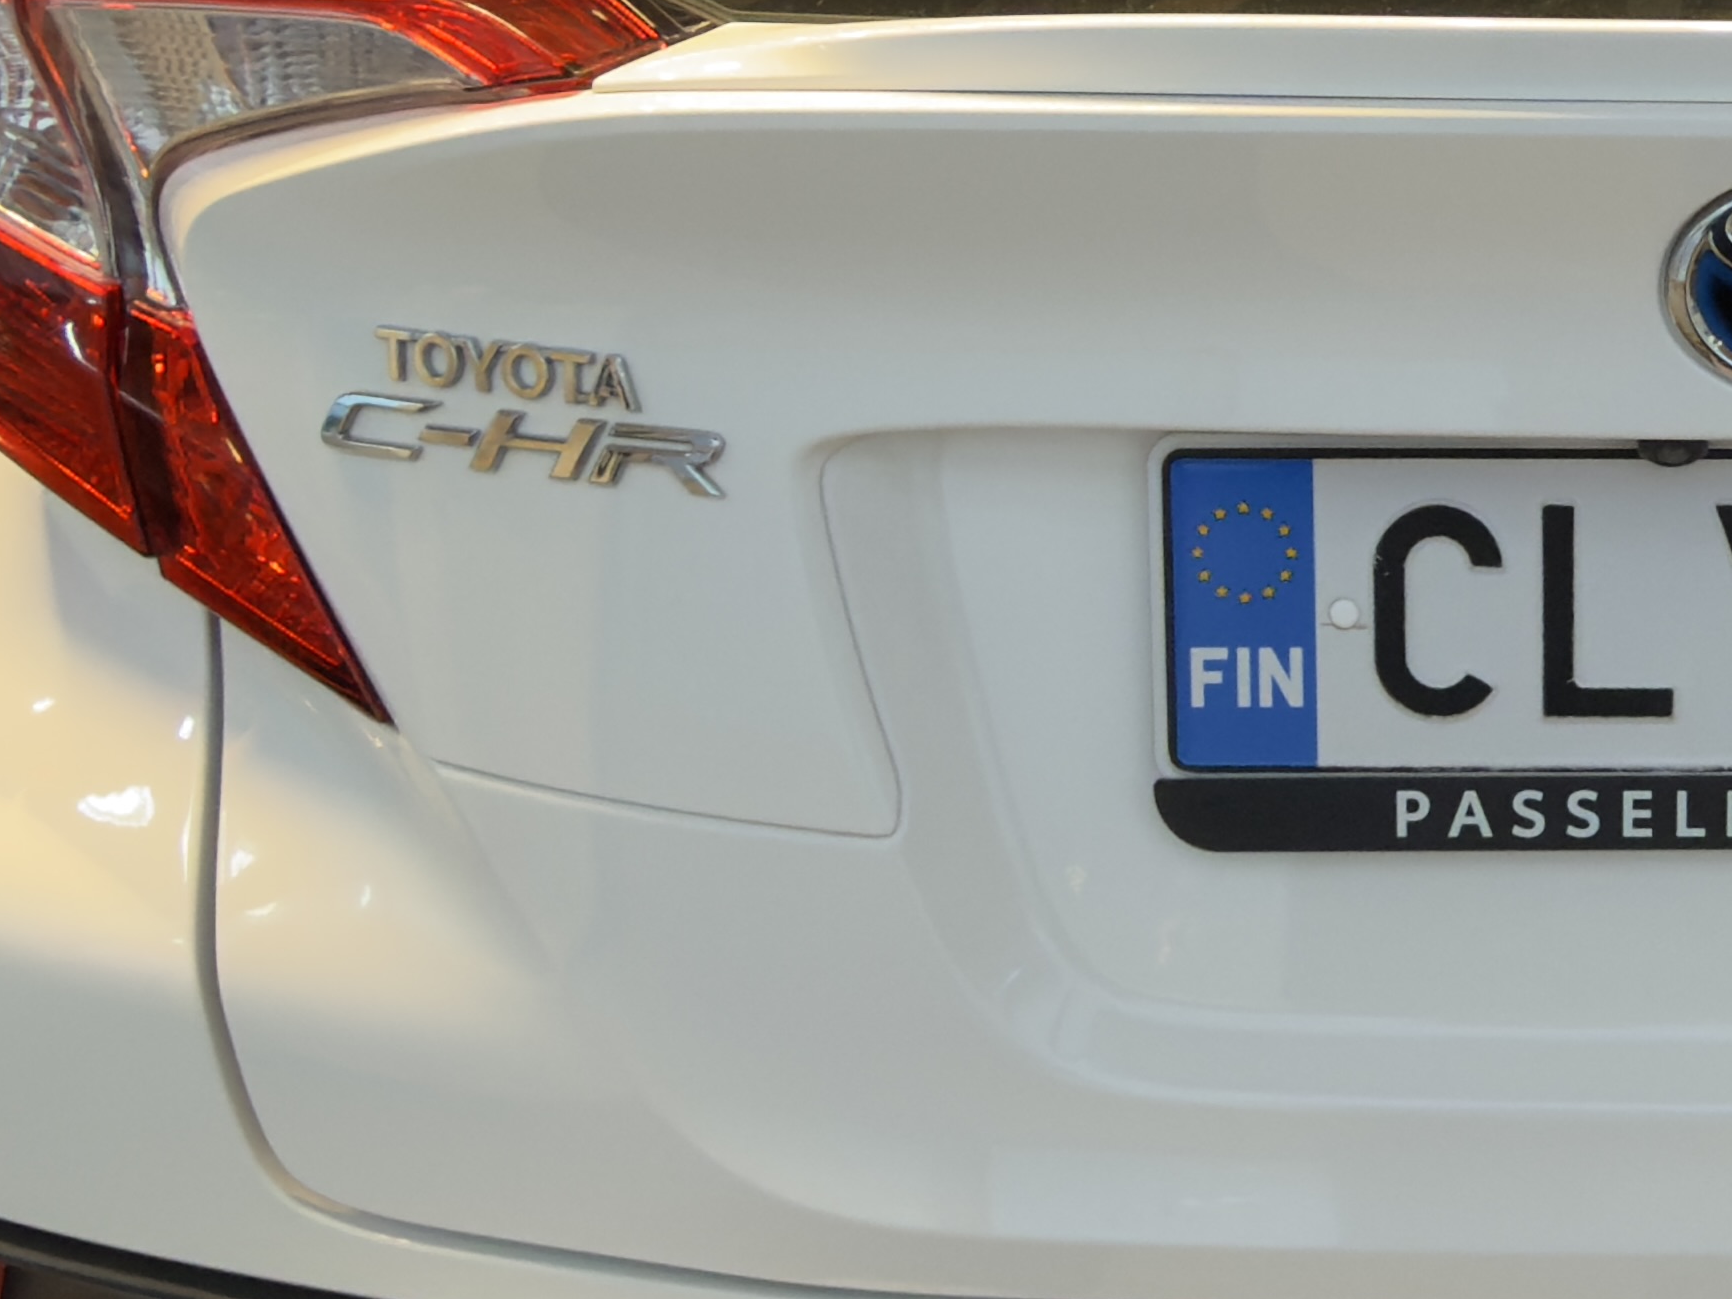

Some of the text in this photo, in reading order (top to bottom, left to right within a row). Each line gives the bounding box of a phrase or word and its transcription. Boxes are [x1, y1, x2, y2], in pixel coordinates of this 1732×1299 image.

[373, 323, 642, 413] TOYOTA
[320, 391, 727, 499] C-HR
[1188, 646, 1305, 709] FIN
